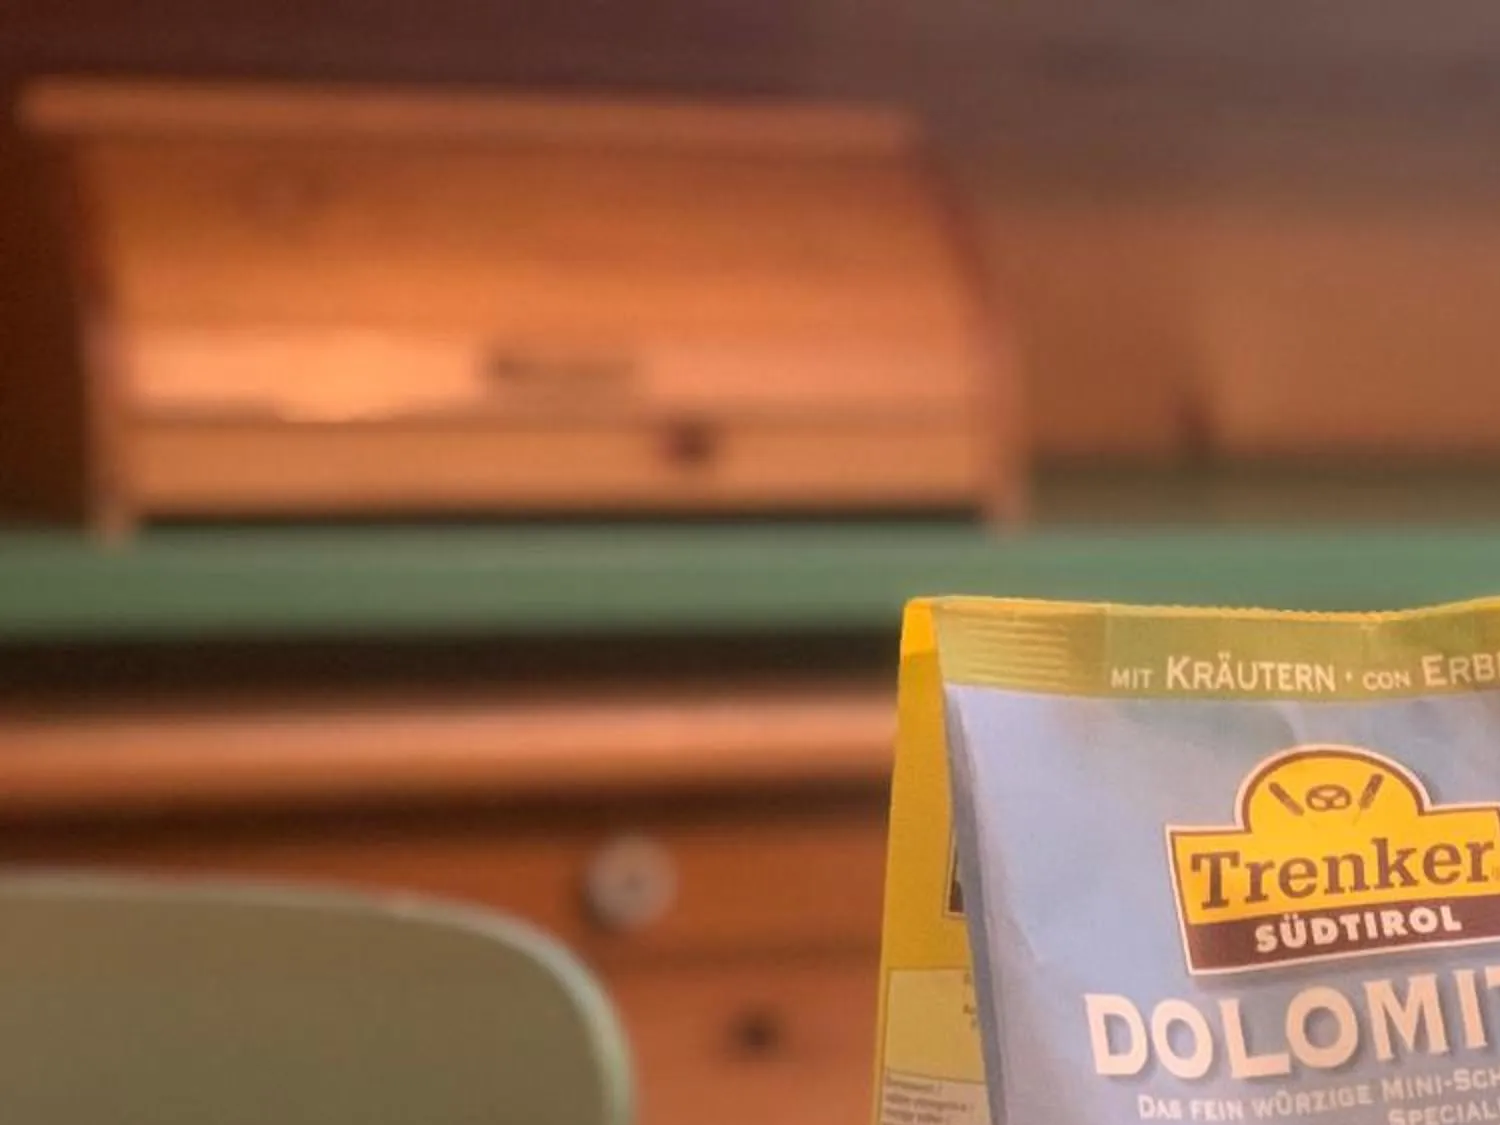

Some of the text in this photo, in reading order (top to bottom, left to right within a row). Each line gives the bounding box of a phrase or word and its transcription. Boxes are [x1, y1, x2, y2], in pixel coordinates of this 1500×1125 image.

[1110, 667, 1152, 689] MIT
[1166, 652, 1336, 692] KRÄUTERN
[1361, 670, 1411, 691] CON
[1190, 837, 1498, 910] Trenker
[1254, 905, 1463, 952] SÜDTIROL
[1137, 1093, 1184, 1122] DAS
[1189, 1100, 1245, 1121] FEIN
